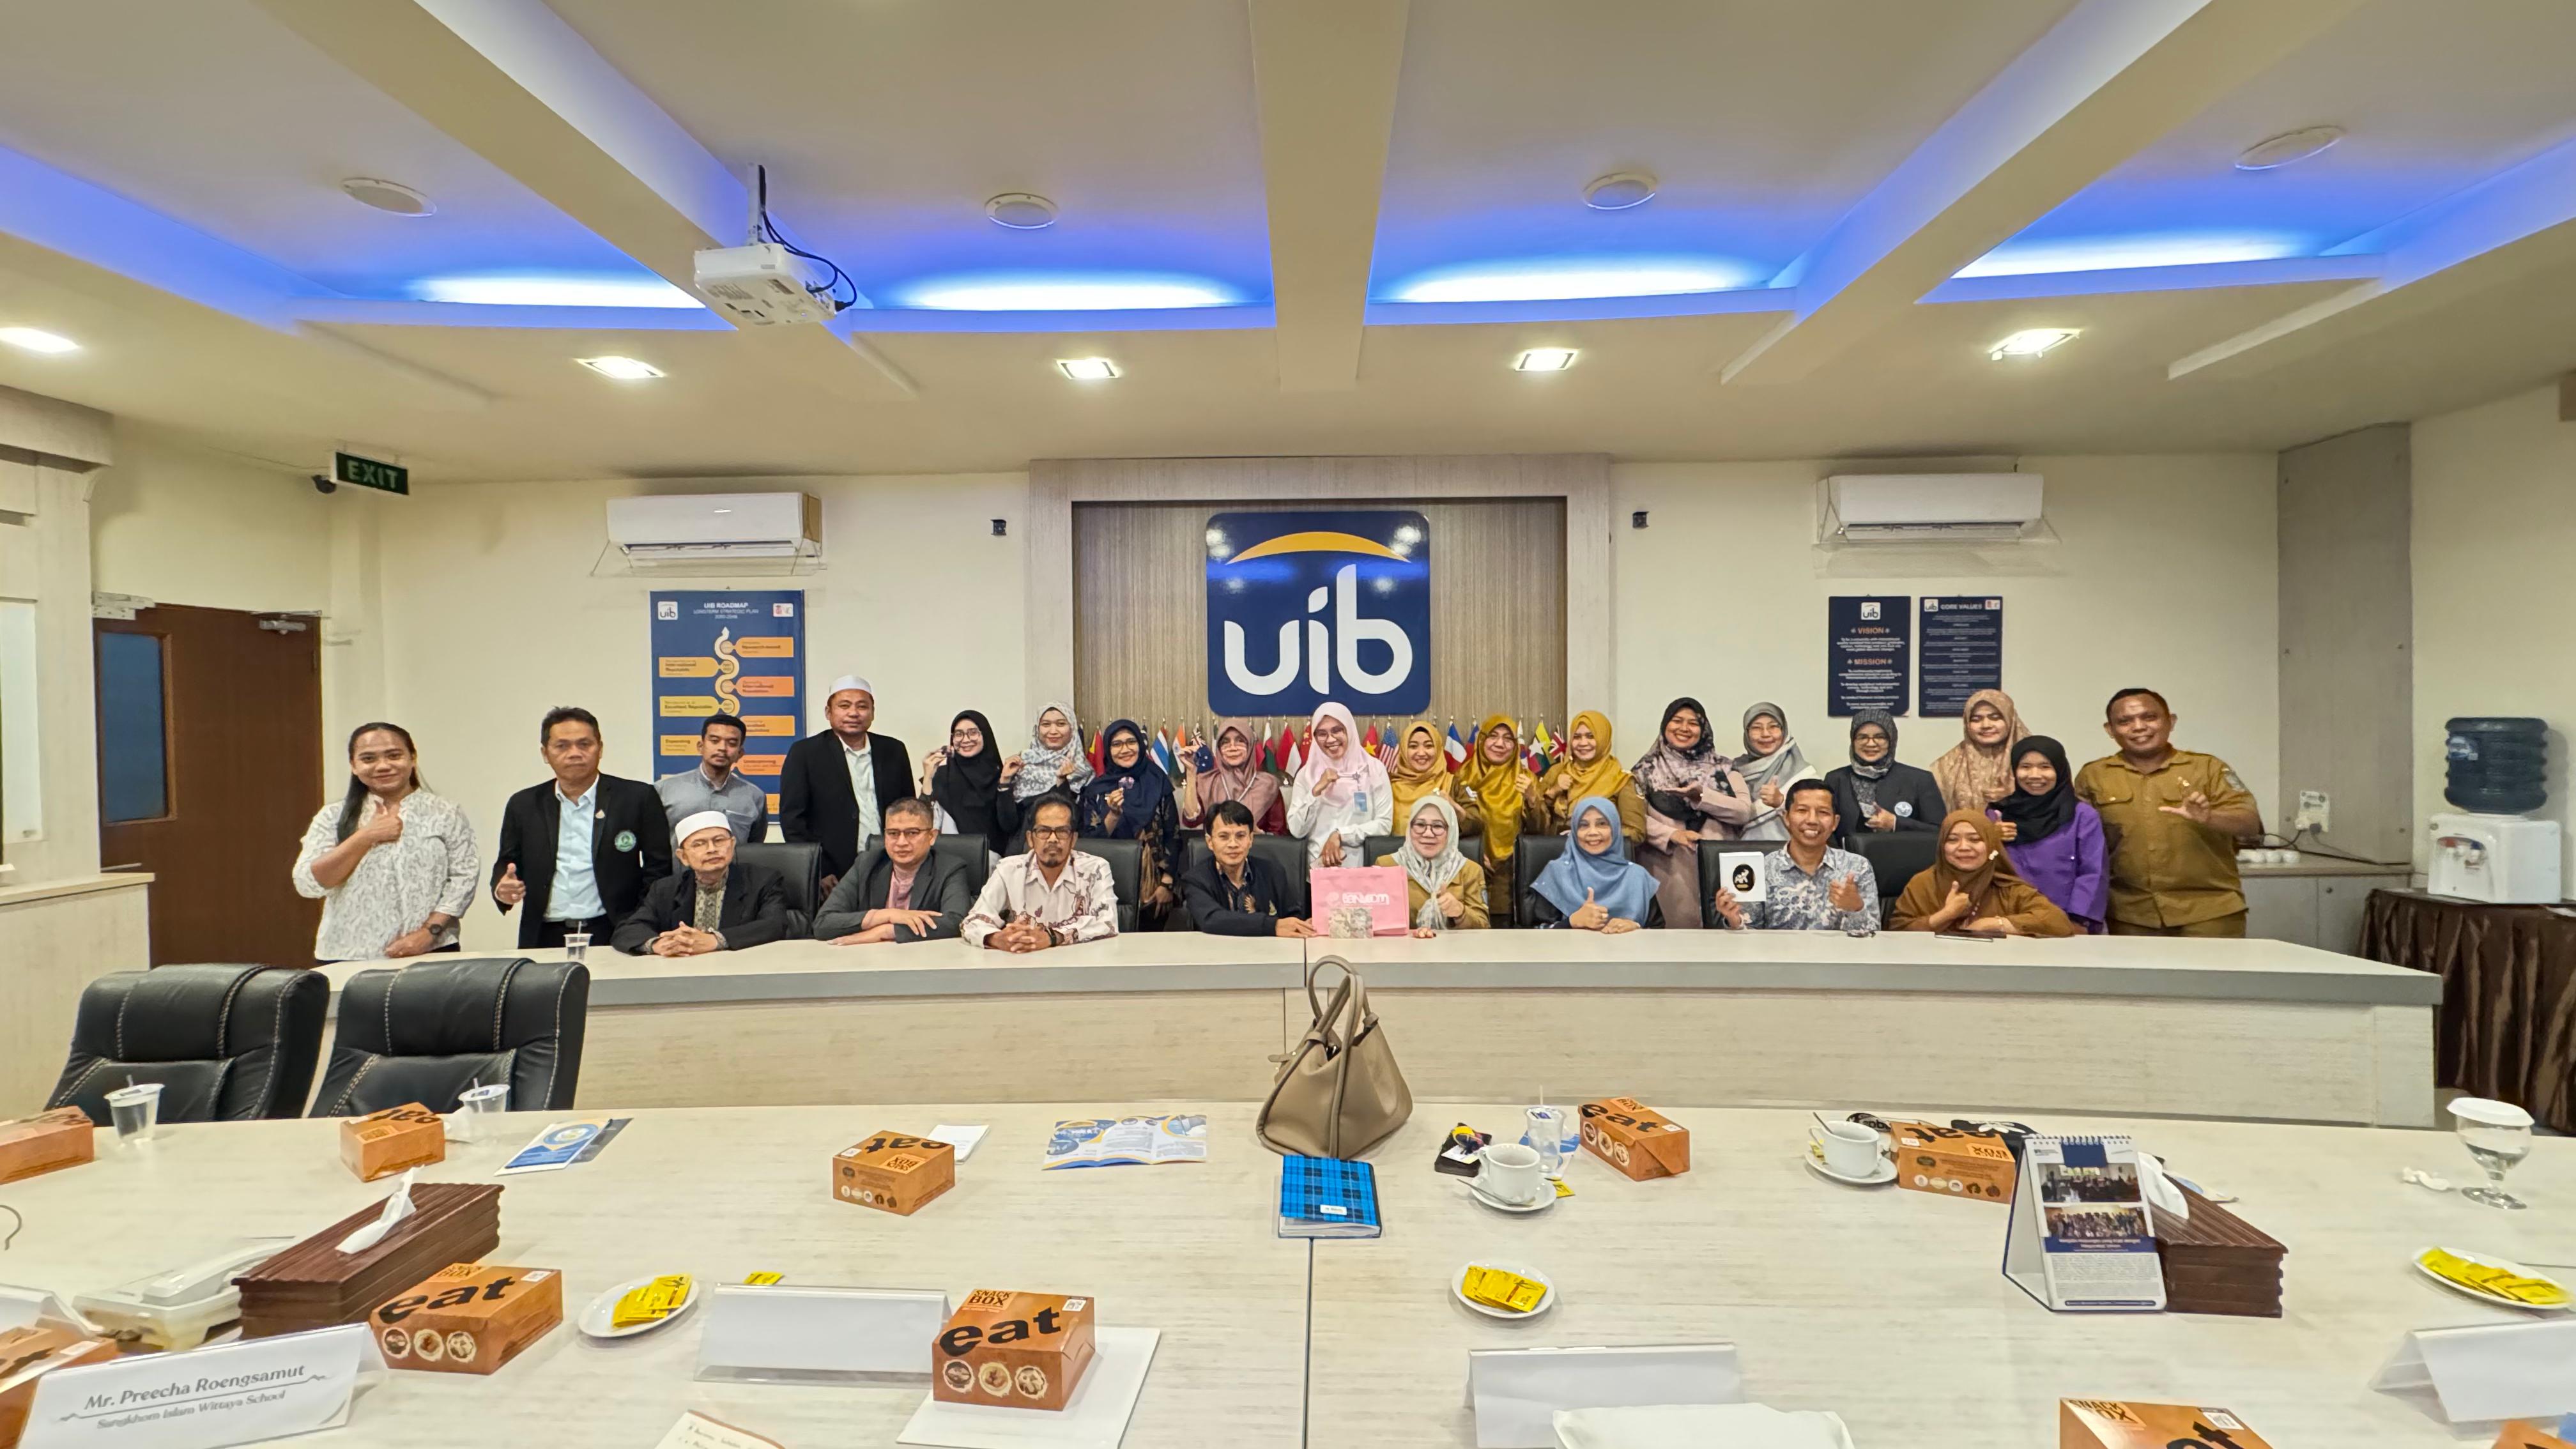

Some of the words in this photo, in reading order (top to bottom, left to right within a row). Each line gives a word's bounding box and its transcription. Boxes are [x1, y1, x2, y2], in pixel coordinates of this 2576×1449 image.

[347, 460, 399, 489] EXIT
[660, 606, 676, 618] uib
[1862, 608, 1878, 618] uib
[1224, 564, 1413, 695] uib
[1581, 1104, 1659, 1133] eat
[864, 1138, 951, 1154] eat
[378, 1276, 514, 1324] eat
[968, 1296, 1008, 1306] BOX
[974, 1290, 1012, 1298] SNACK
[939, 1307, 1061, 1356] eat
[84, 1394, 115, 1409] Mr.
[120, 1383, 190, 1404] Preecha
[195, 1365, 305, 1392] Roengsamut
[246, 1390, 286, 1405] School
